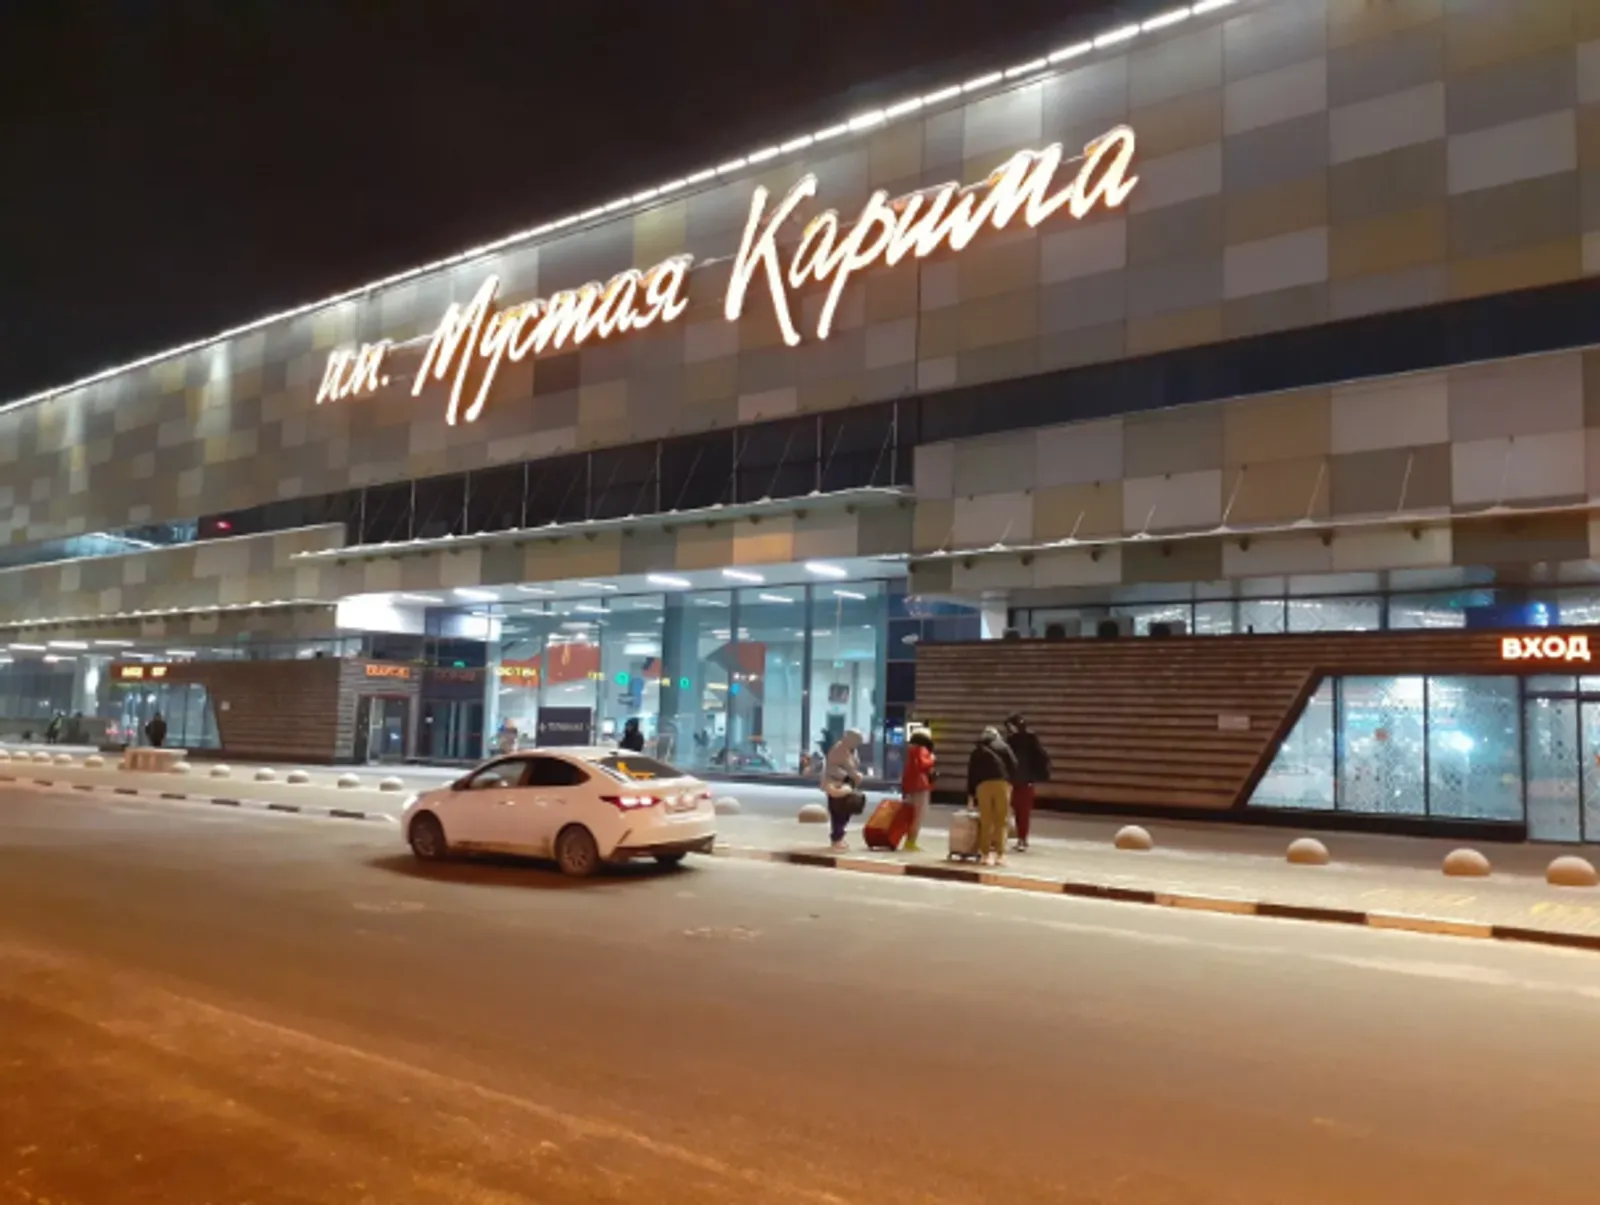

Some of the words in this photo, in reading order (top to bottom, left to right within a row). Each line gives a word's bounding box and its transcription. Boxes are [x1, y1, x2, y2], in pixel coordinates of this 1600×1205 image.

[315, 341, 391, 405] им.
[410, 252, 692, 426] Мустая
[723, 124, 1139, 347] Карима
[1502, 635, 1591, 662] ВХОД
